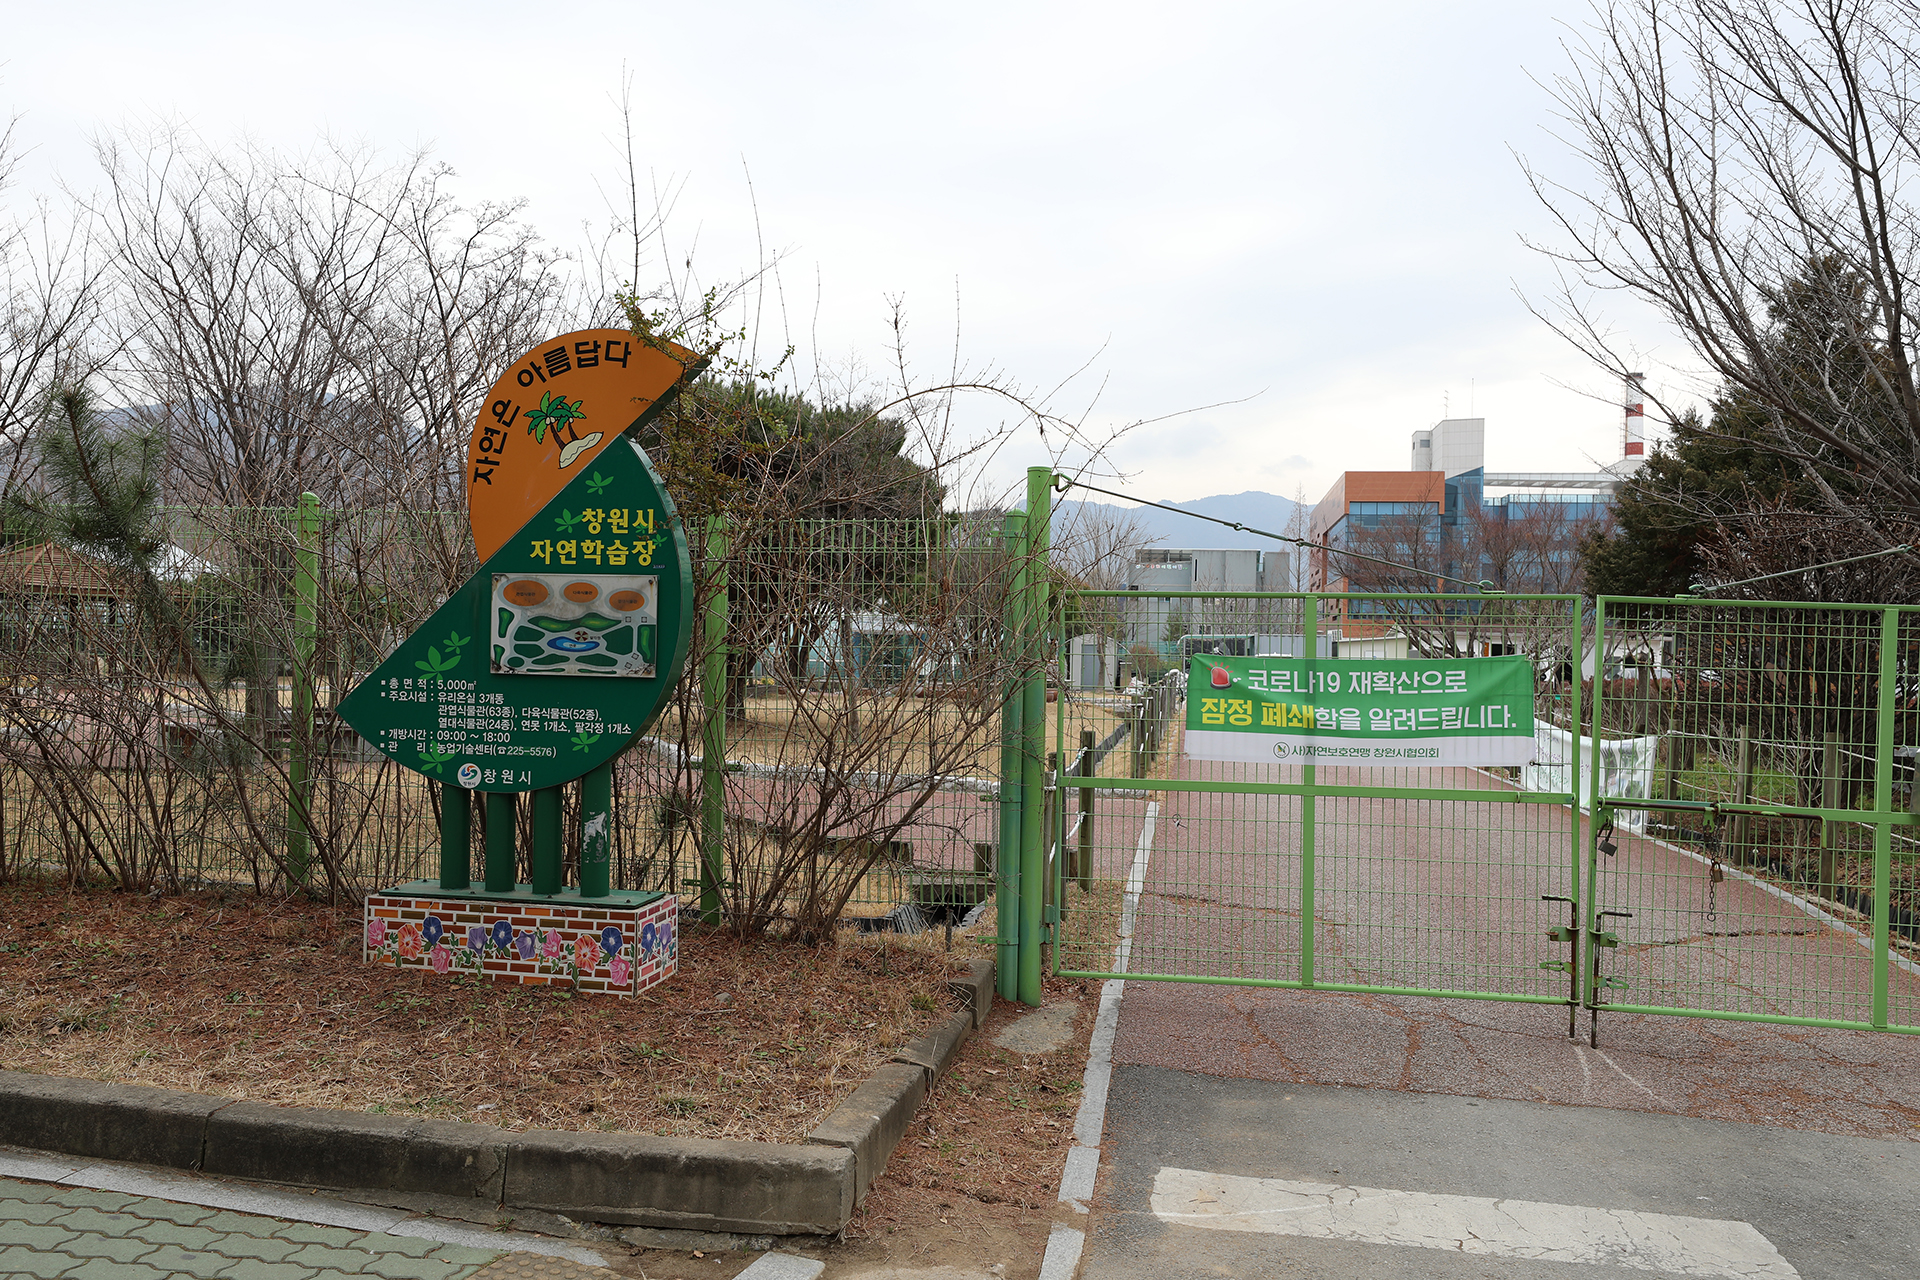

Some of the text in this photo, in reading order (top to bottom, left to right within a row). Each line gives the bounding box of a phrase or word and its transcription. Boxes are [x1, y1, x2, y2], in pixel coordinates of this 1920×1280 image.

[473, 340, 632, 485] 자연은 아름답다
[581, 508, 654, 534] 창원시
[529, 539, 656, 566] 자연학습장
[1248, 669, 1467, 695] 코로나19 재확산으로
[388, 690, 427, 702] 주요시설
[437, 691, 476, 704] 유리온실
[478, 693, 504, 705] 3개동
[1200, 697, 1517, 731] 잠정 폐쇄함을 알려드립니다.
[388, 728, 427, 740] 개방시간
[437, 730, 467, 741] 09:00
[482, 732, 511, 743] 18:00
[521, 720, 540, 732] 연못
[543, 720, 571, 733] 1개소,
[574, 721, 604, 734] 팔각정
[607, 723, 632, 735] 1개소
[1373, 747, 1439, 758] 창원시협의회
